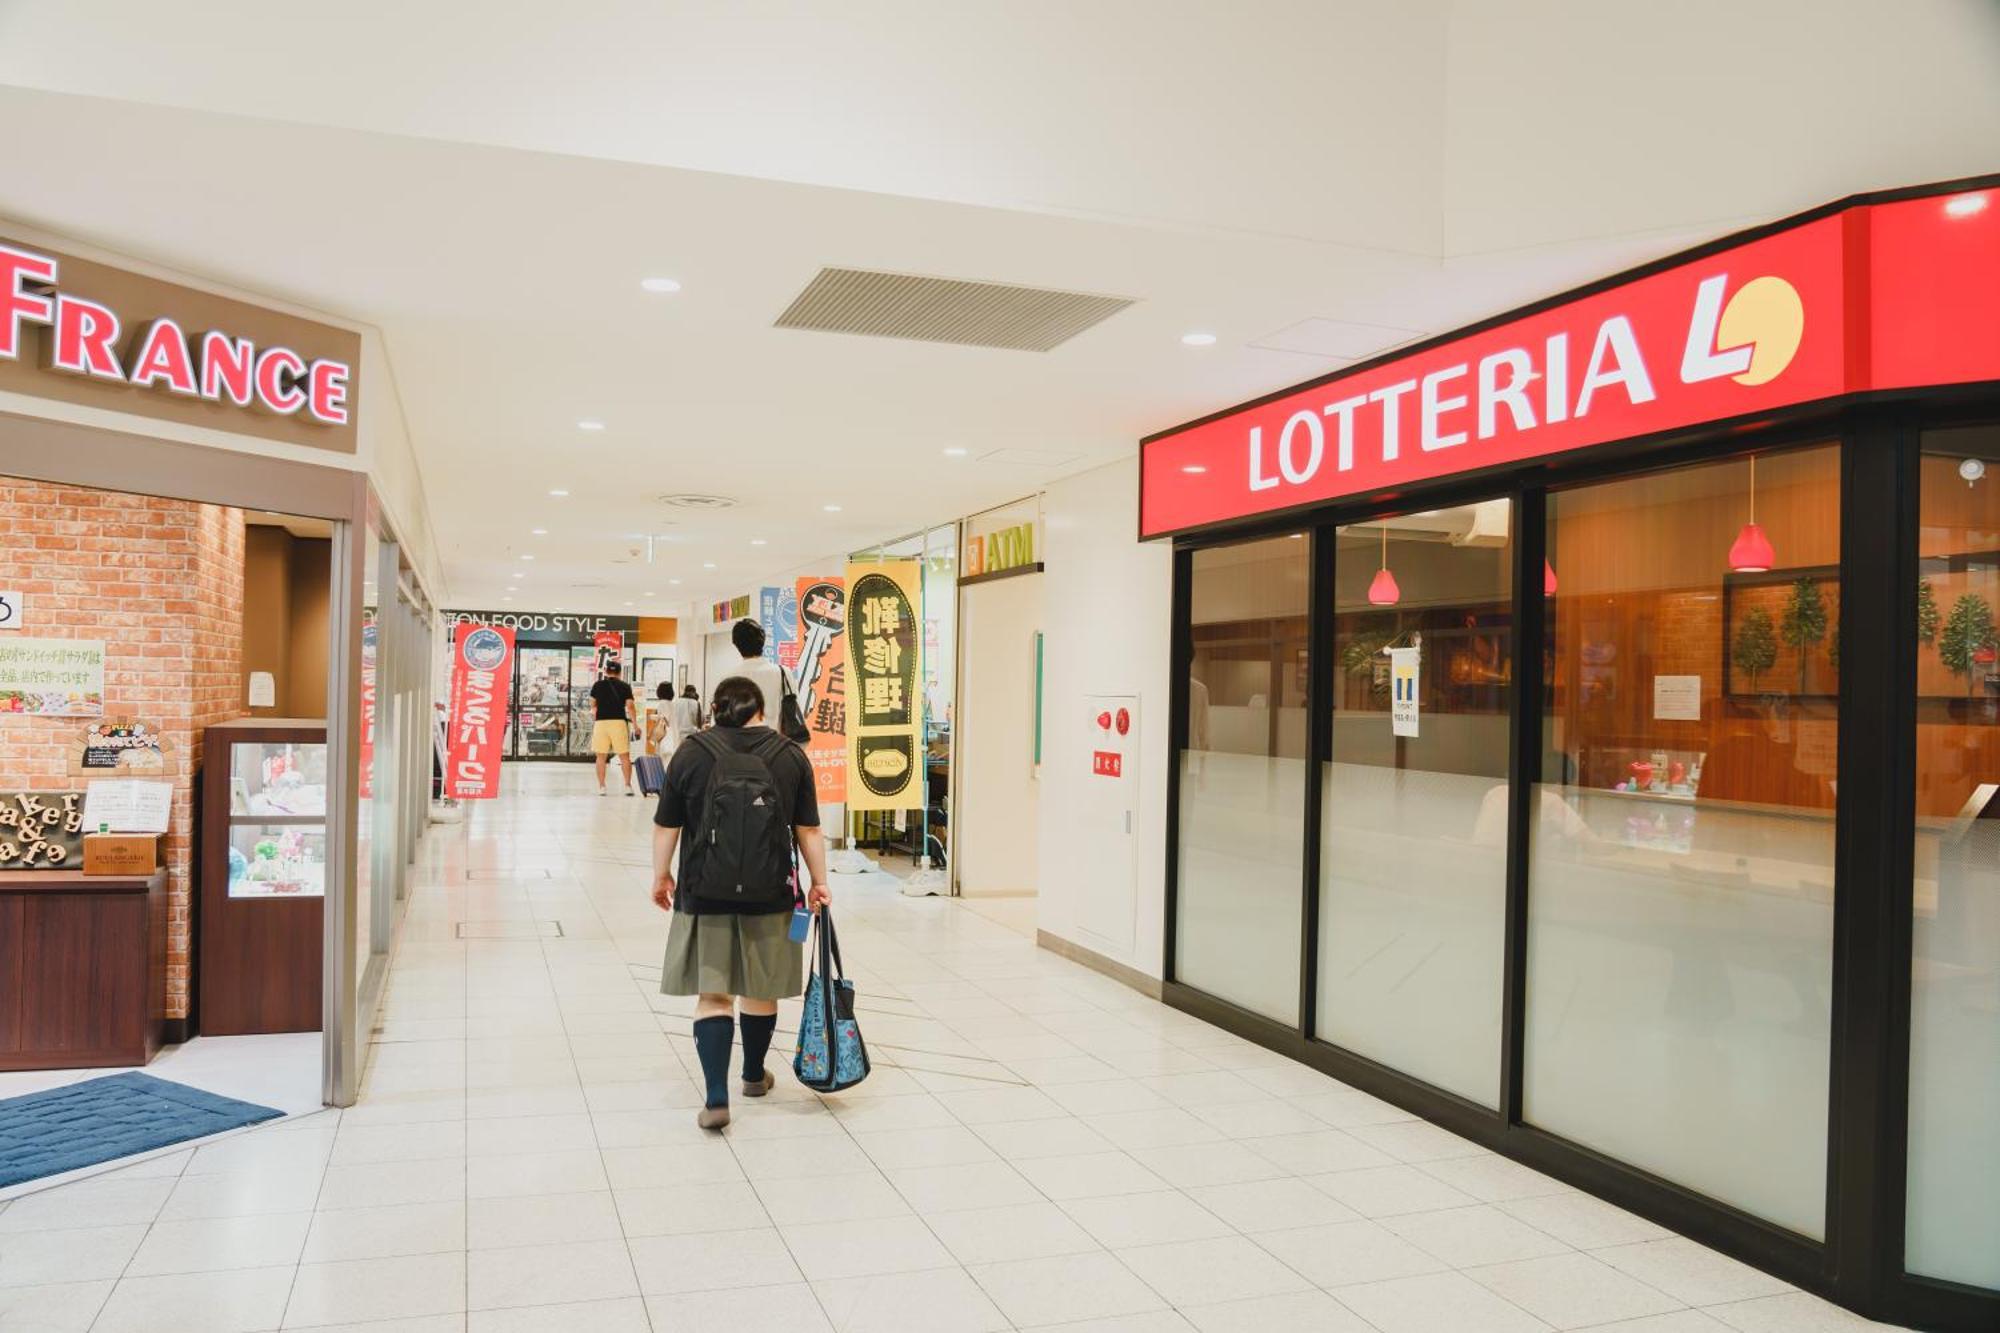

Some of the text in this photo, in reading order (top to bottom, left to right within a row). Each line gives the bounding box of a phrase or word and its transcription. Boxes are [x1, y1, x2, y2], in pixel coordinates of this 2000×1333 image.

[0, 246, 349, 425] FRANCE
[1248, 313, 1656, 493] LOTTERIA
[986, 523, 1032, 575] ATM
[493, 614, 547, 631] FOOD
[552, 616, 606, 633] STYLE
[0, 793, 84, 833] akery
